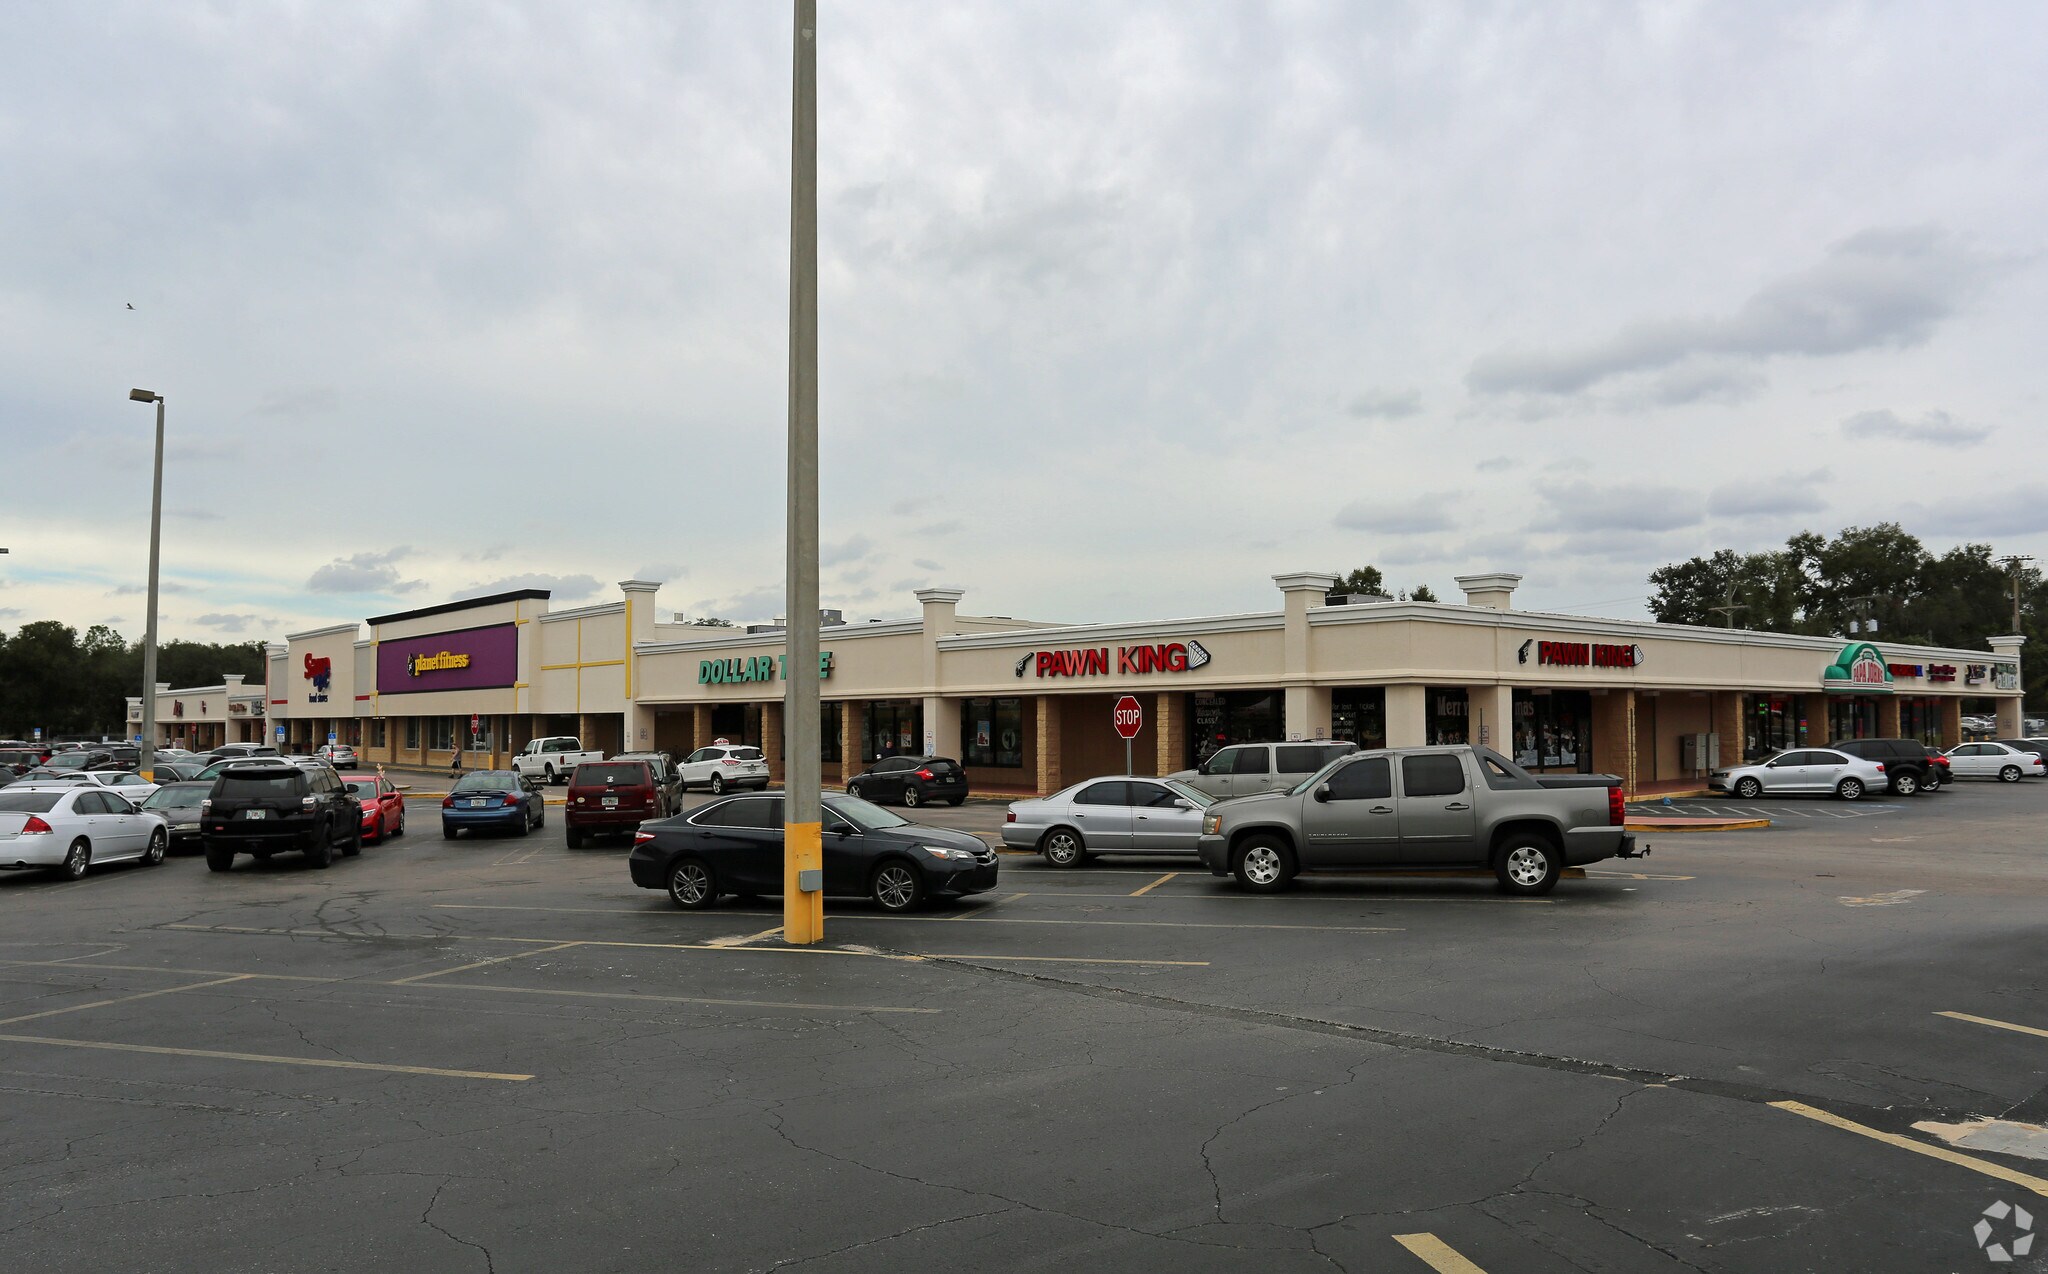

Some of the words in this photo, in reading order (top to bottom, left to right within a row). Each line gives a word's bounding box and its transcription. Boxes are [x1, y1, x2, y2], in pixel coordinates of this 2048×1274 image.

[415, 653, 438, 676] planet
[438, 651, 469, 670] fitness
[1036, 647, 1108, 677] PAWN
[1118, 643, 1187, 674] KING
[1538, 641, 1589, 666] PAWN
[1592, 644, 1633, 667] KING
[698, 655, 774, 685] DOLLAR
[778, 651, 833, 681] TE
[1853, 662, 1867, 682] PAPA
[1116, 709, 1140, 725] STOP
[1437, 696, 1469, 716] Merry
